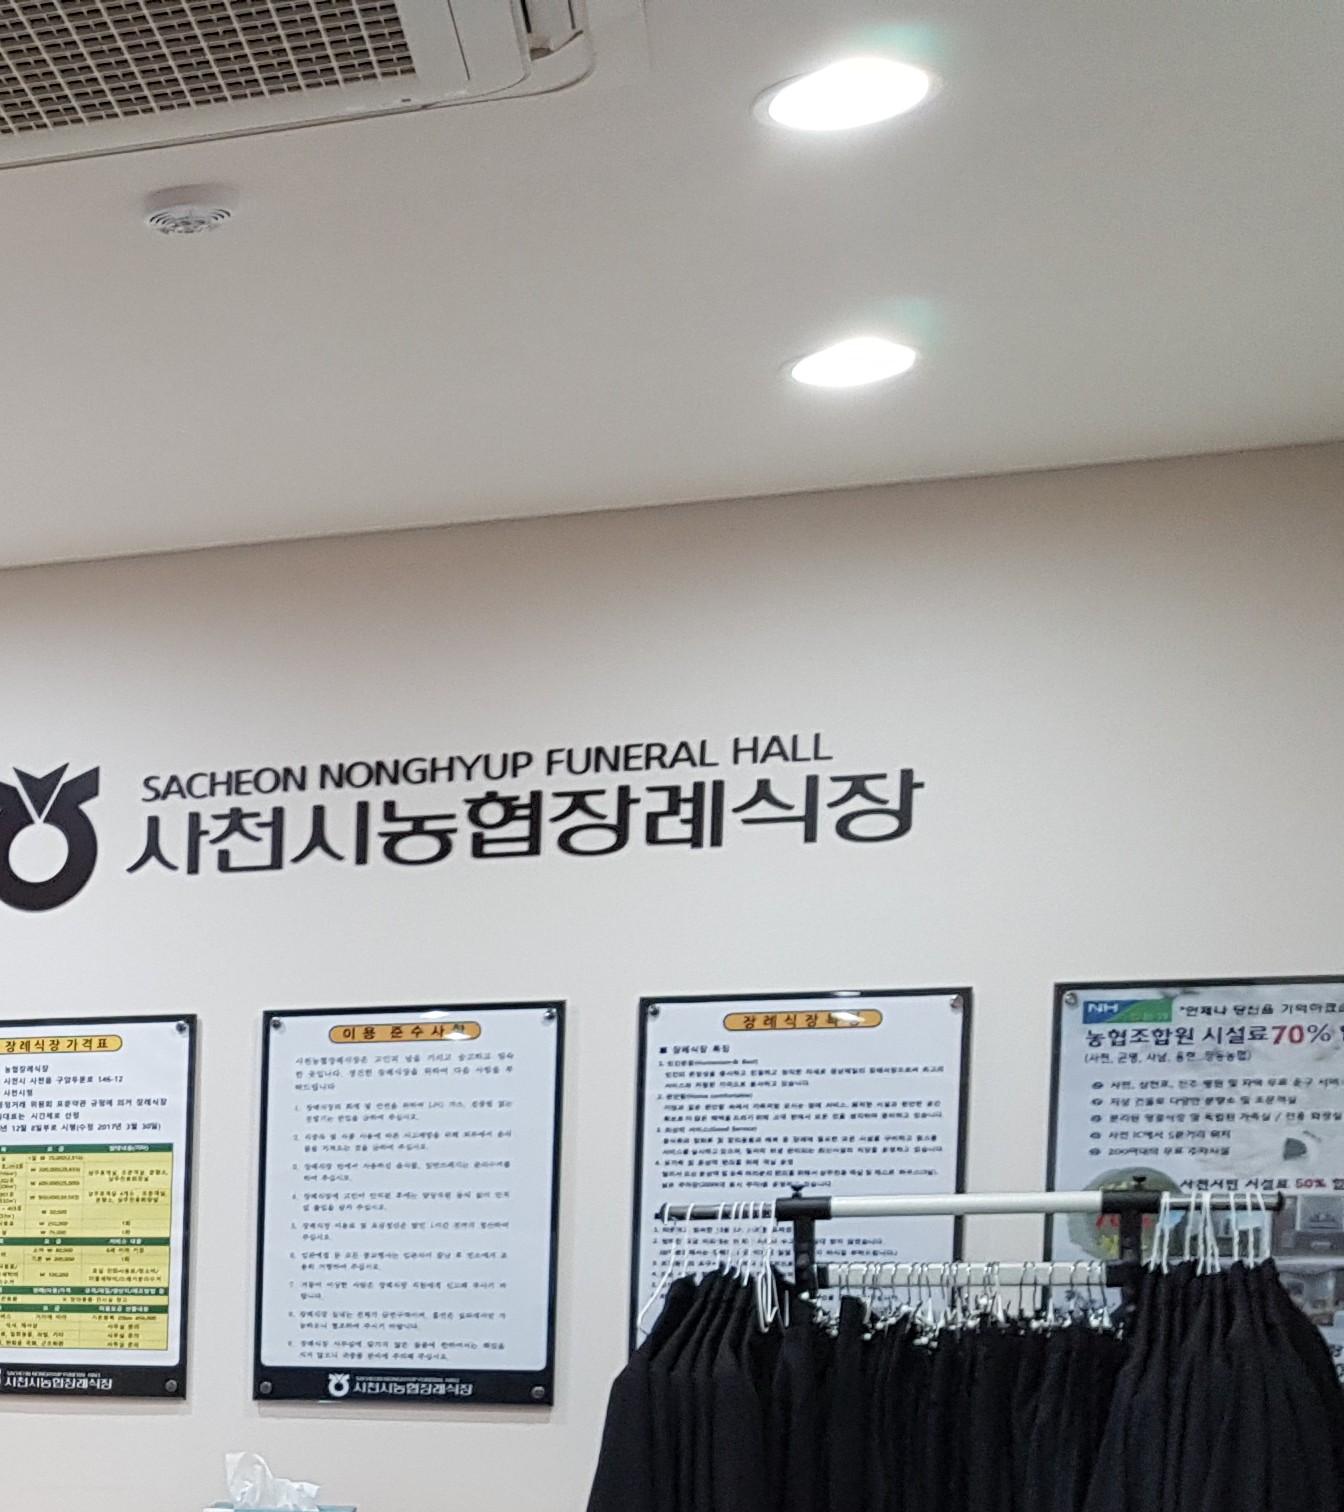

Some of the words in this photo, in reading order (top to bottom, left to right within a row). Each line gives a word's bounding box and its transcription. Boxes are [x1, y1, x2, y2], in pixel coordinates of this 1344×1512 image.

[141, 766, 307, 802] SACHEON
[319, 751, 533, 790] NONGHYUP
[545, 739, 720, 776] FUNERAL
[732, 732, 834, 766] HALL
[125, 767, 925, 875] 사천시농협장례식장
[1087, 1002, 1120, 1013] NH
[1085, 1026, 1195, 1047] 농협조합원
